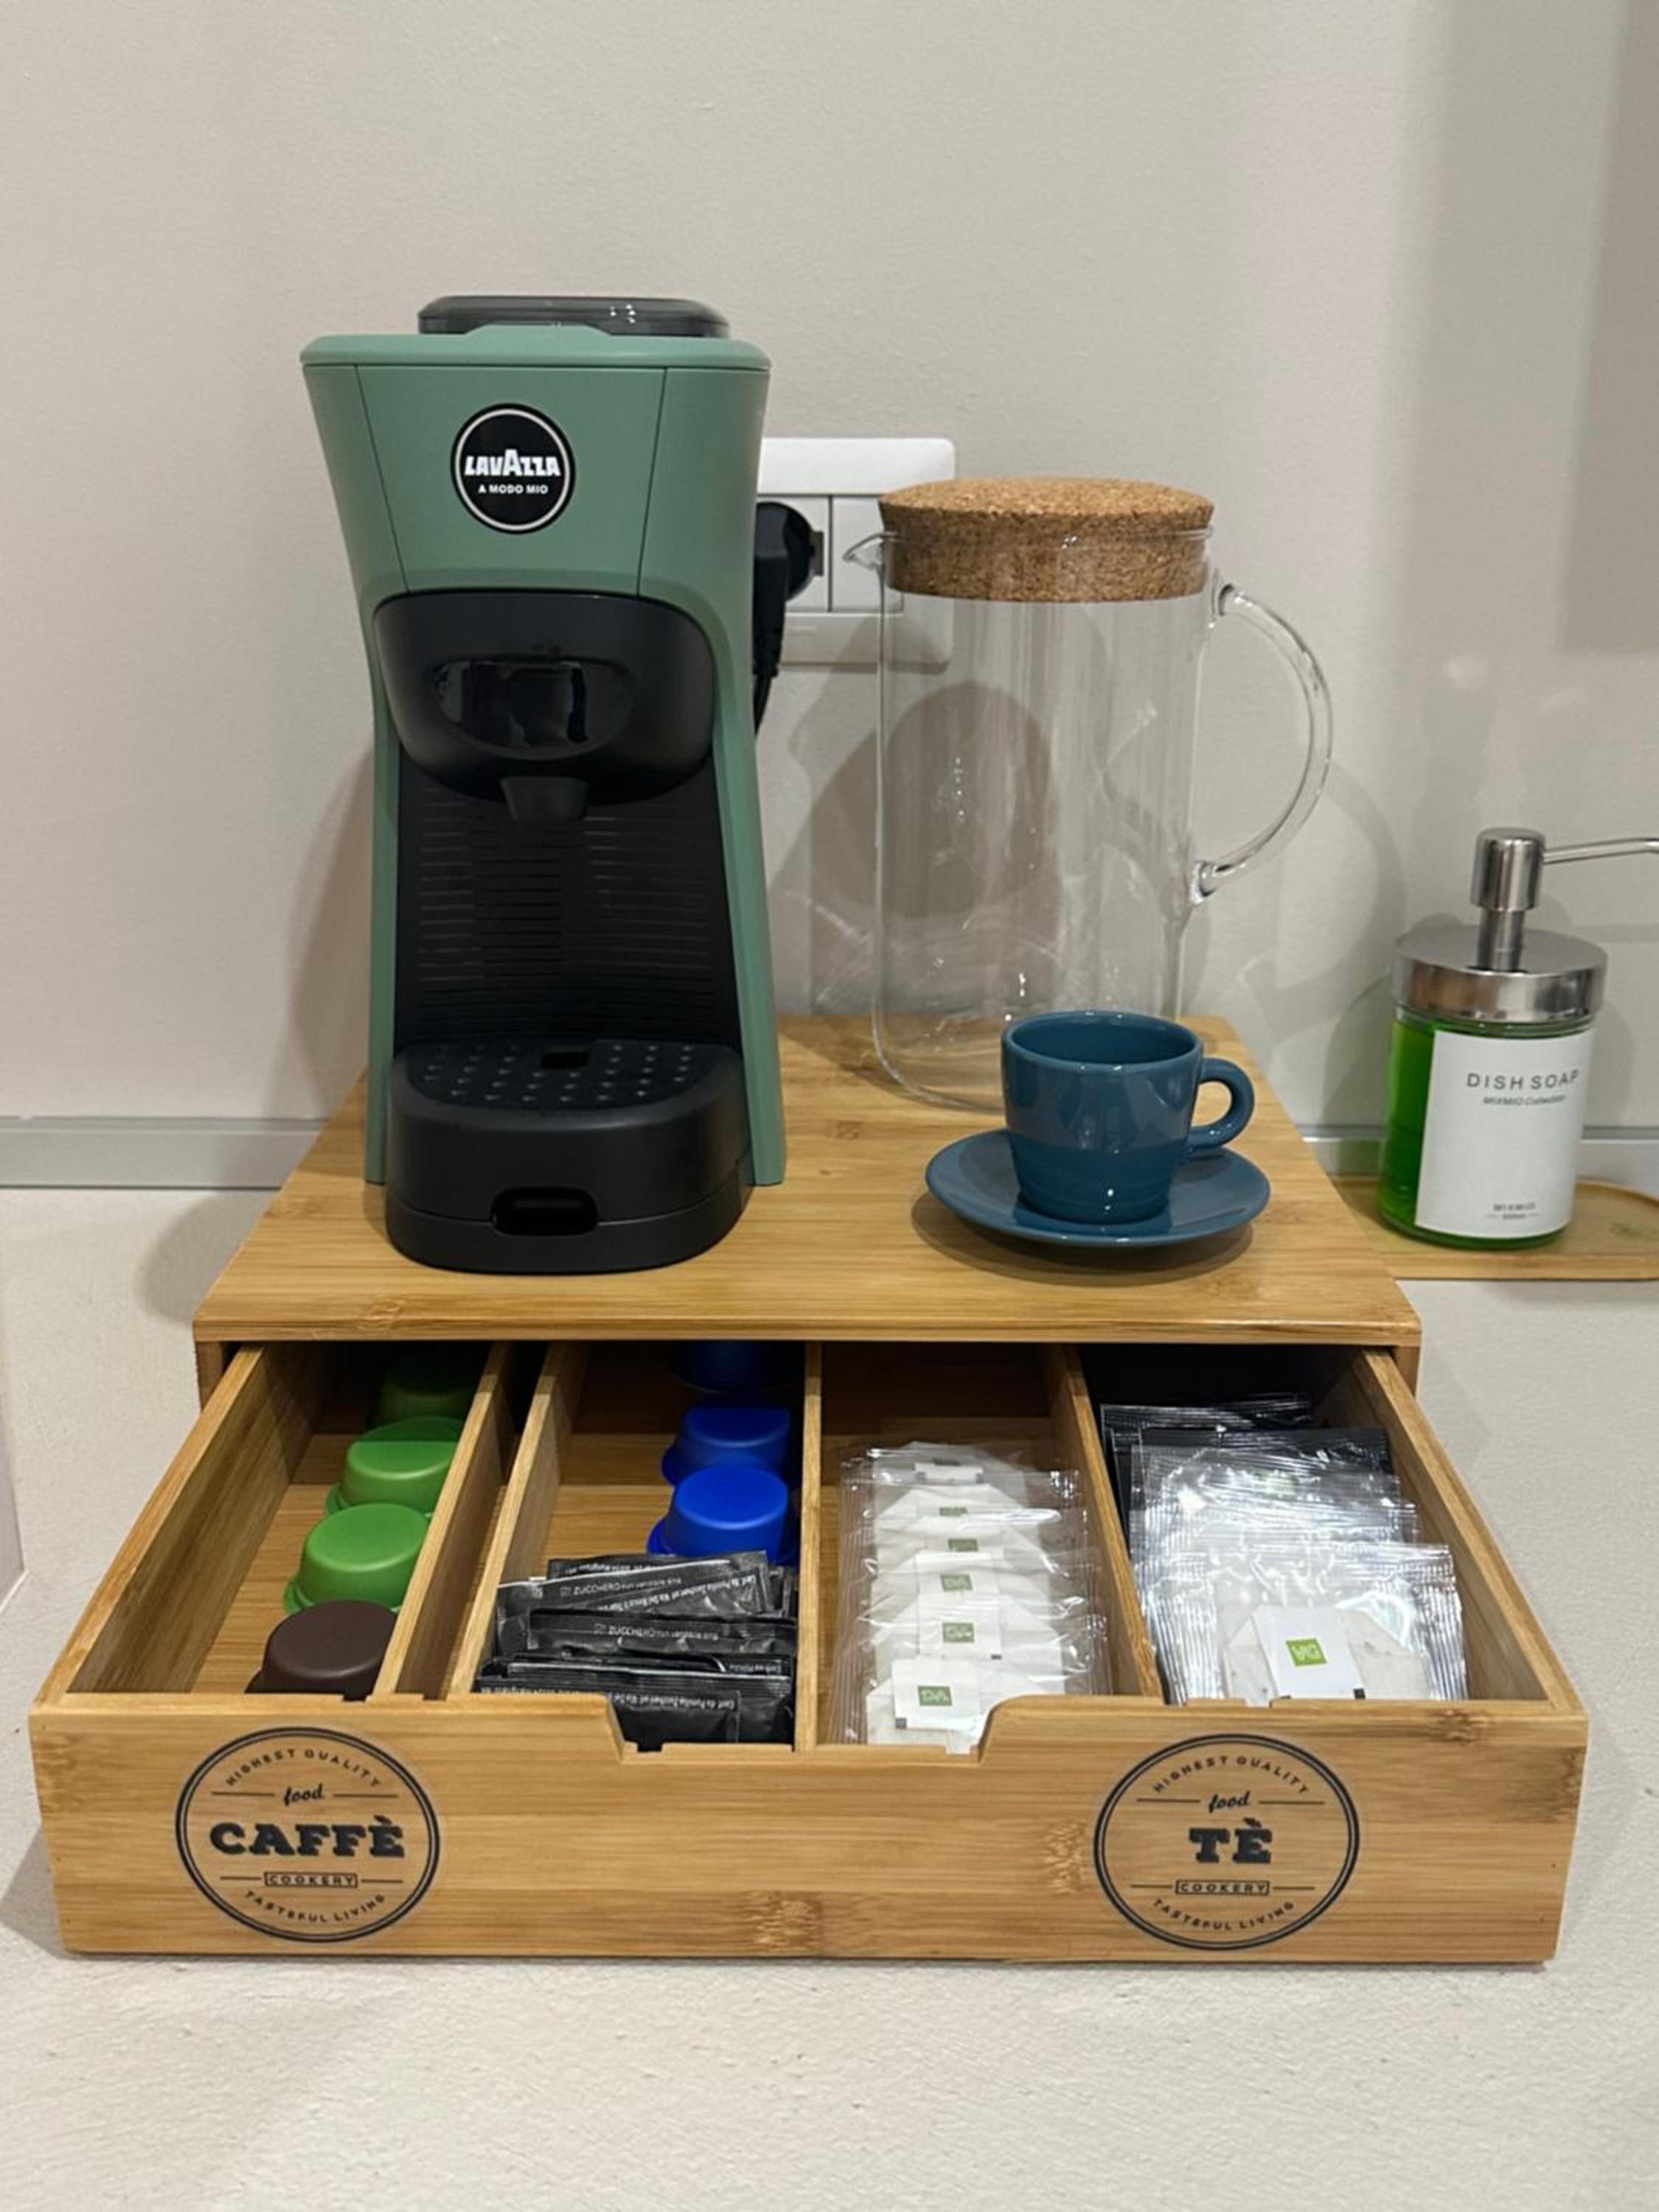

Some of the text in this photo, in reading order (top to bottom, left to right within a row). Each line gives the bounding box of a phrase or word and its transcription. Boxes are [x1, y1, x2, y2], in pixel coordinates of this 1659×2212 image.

[465, 448, 561, 476] LAVAZZA
[478, 484, 549, 495] A MODO MIO
[1467, 1069, 1579, 1091] DISH SOAP
[226, 1748, 380, 1787] HIGHEST QUALITY
[1153, 1756, 1310, 1794] HIGHEST QUALITY
[283, 1783, 324, 1806] food
[1208, 1790, 1252, 1813] food
[209, 1815, 405, 1858] CAFFÈ
[1188, 1817, 1273, 1863] TÈ
[268, 1874, 355, 1886] COOKERY
[1180, 1882, 1266, 1893] COOKERY
[244, 1891, 386, 1923] TASTEFUL LIVING
[1152, 1898, 1295, 1931] TASTEFUL LIVING
